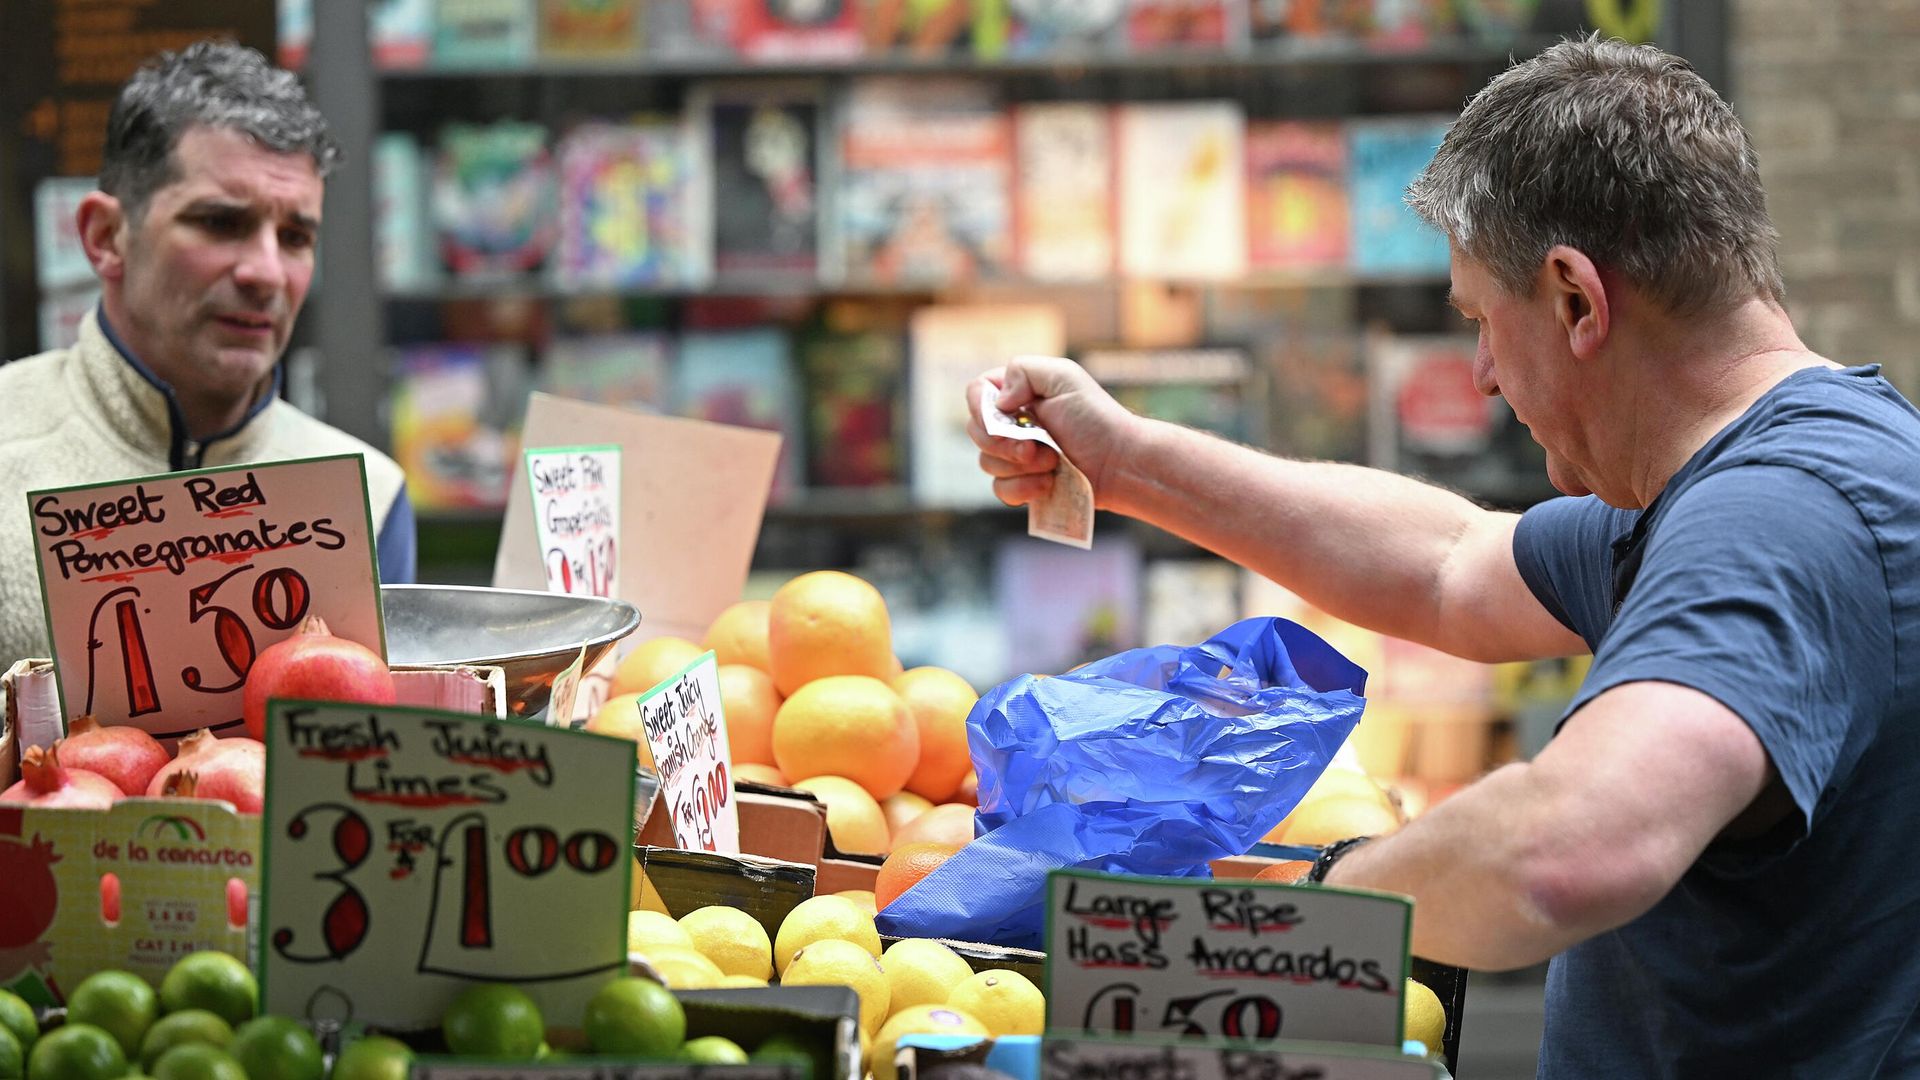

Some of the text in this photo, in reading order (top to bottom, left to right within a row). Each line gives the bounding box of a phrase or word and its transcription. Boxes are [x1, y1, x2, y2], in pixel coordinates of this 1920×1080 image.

[34, 471, 267, 537] Sweet Red
[50, 518, 346, 579] Pomegranates
[643, 674, 708, 743] Sweet Juicy
[284, 708, 554, 788] Fresh Juicy
[346, 760, 508, 804] Limes
[94, 840, 119, 861] de
[128, 840, 149, 861] la
[273, 803, 372, 964] 3
[1063, 880, 1305, 946] Large Ripe
[1067, 927, 1393, 993] Hass Avocardos
